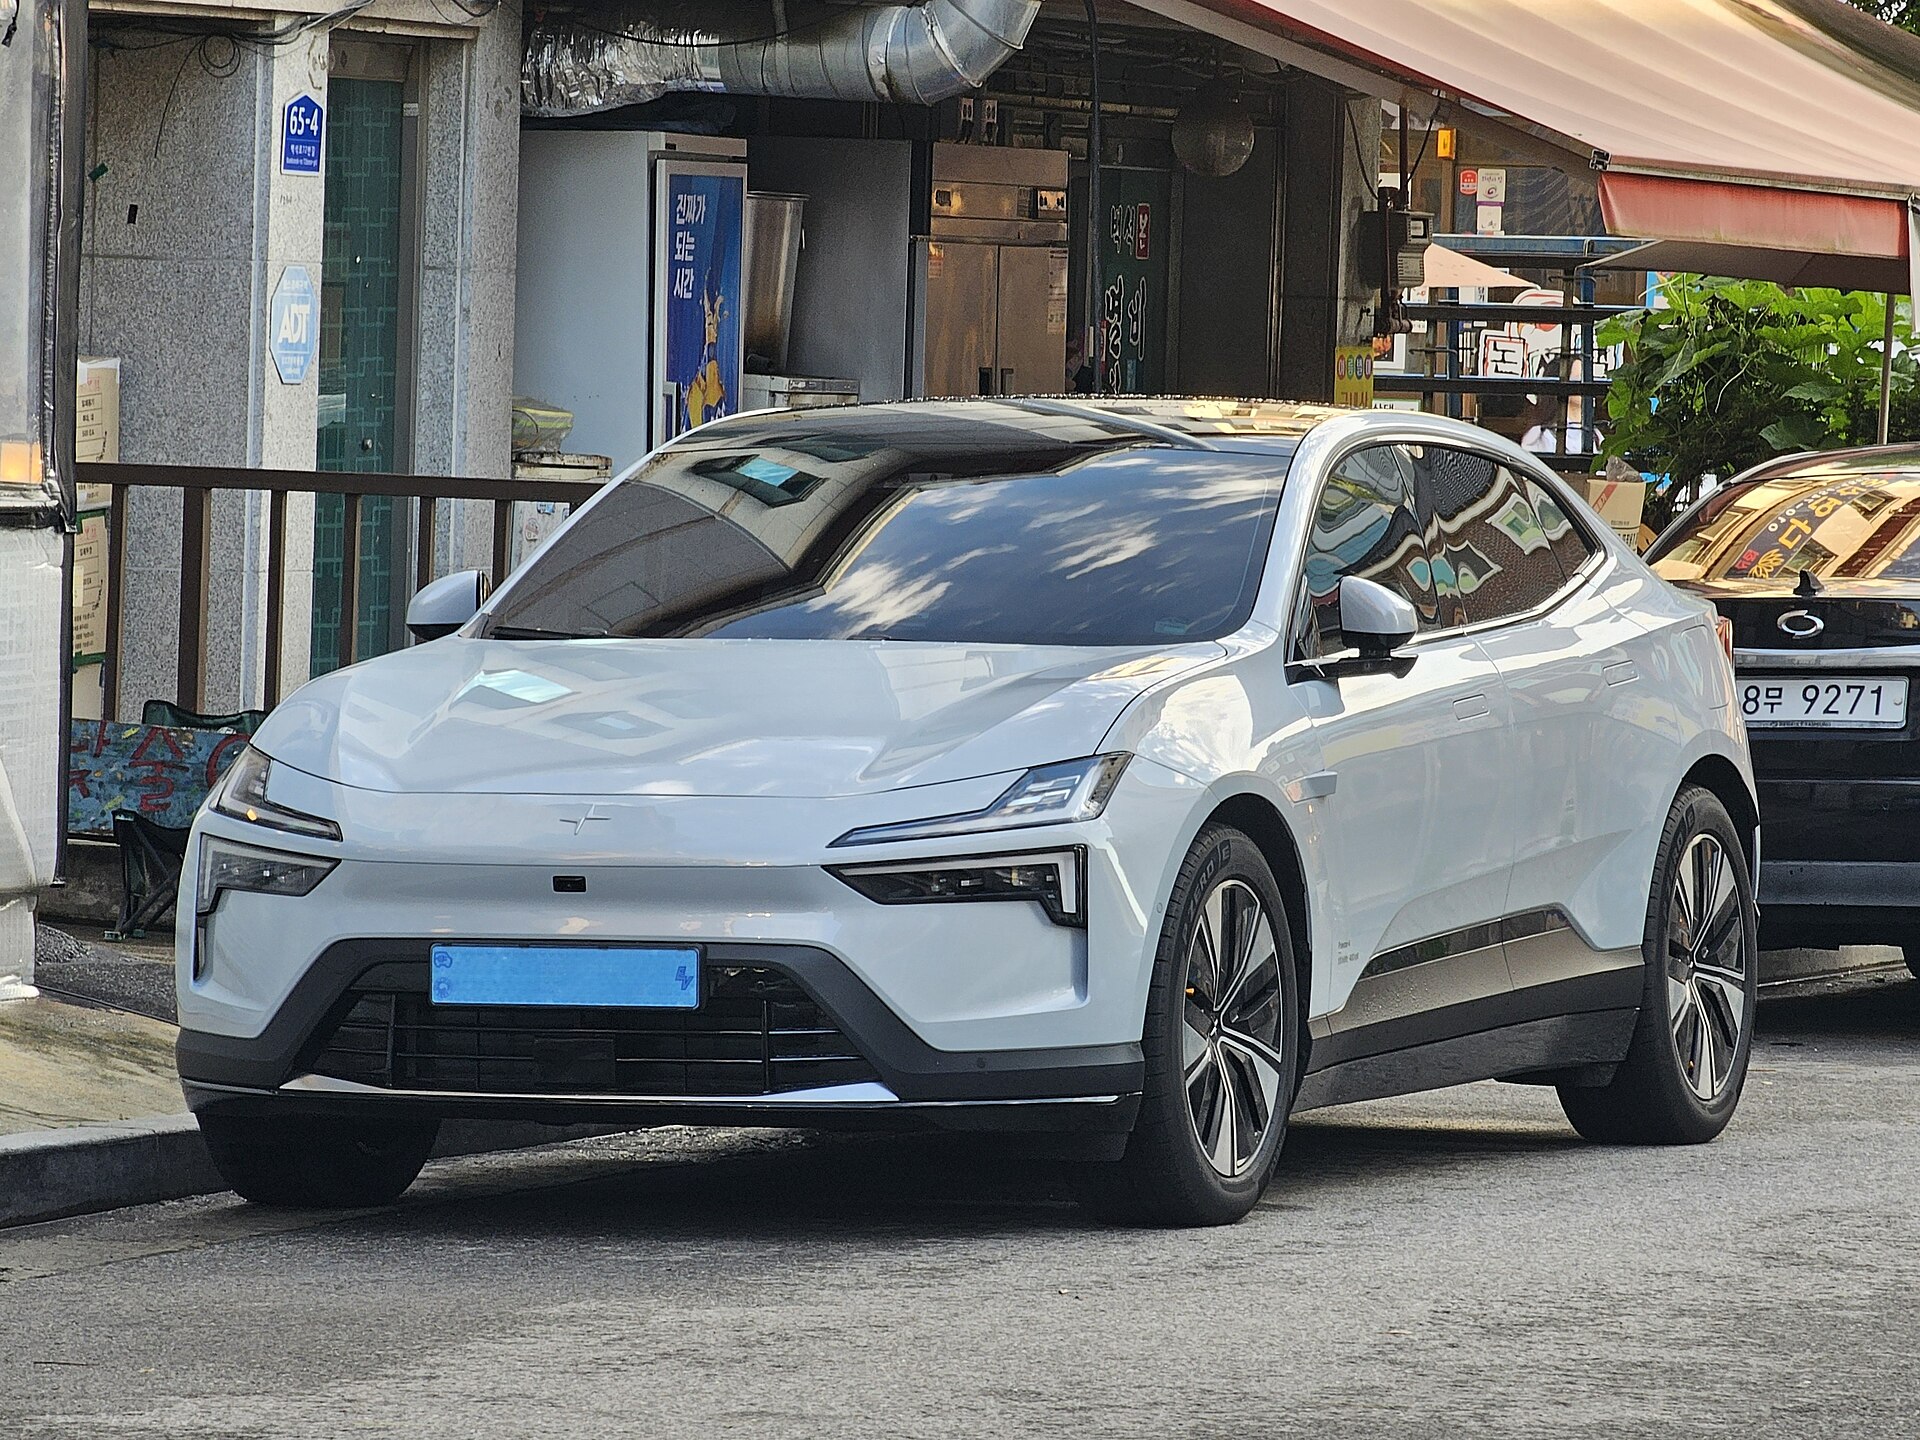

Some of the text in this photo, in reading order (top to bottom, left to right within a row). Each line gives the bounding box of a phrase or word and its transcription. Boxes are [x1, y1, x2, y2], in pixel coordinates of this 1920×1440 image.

[289, 105, 319, 137] 65-4
[676, 193, 706, 225] 진짜가
[674, 230, 696, 262] 되는
[673, 267, 695, 299] 시간
[277, 303, 311, 344] ADT
[1802, 684, 1883, 716] 9271
